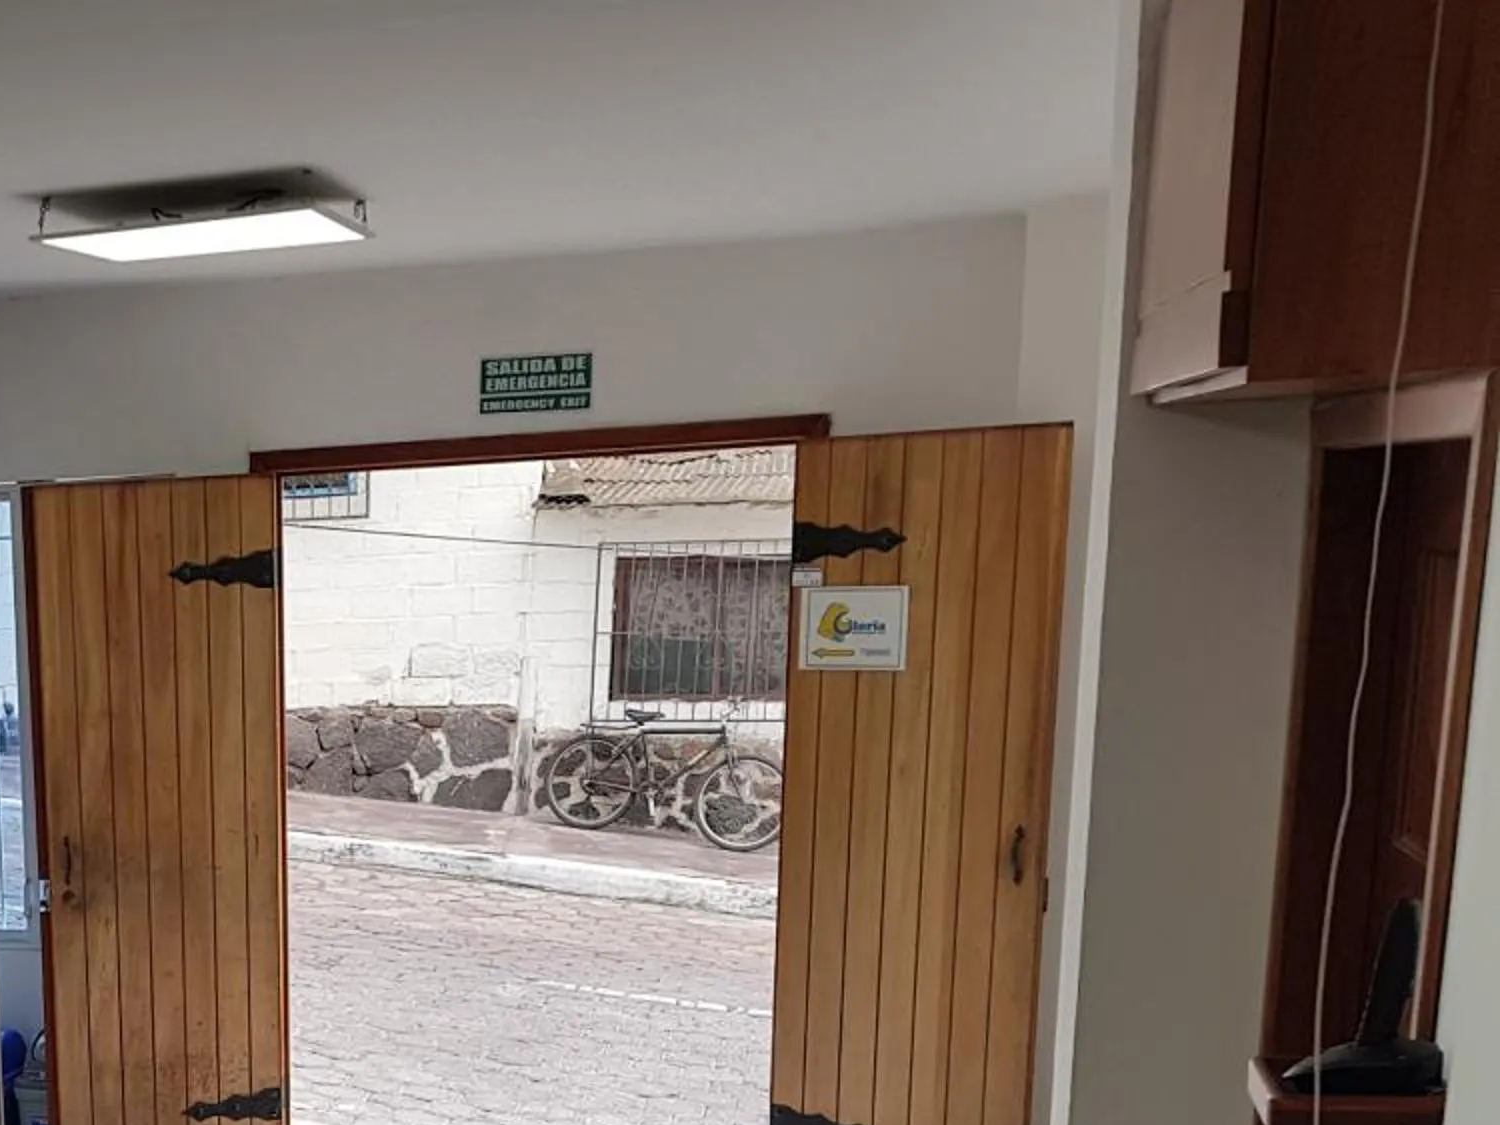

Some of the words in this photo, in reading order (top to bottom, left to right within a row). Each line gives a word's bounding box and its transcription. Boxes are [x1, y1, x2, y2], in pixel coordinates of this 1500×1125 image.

[485, 357, 557, 376] SALIDA
[561, 355, 587, 371] DE
[485, 372, 586, 391] EMERGENCIA
[483, 397, 556, 411] EMERGENCY
[560, 395, 588, 408] EXIT
